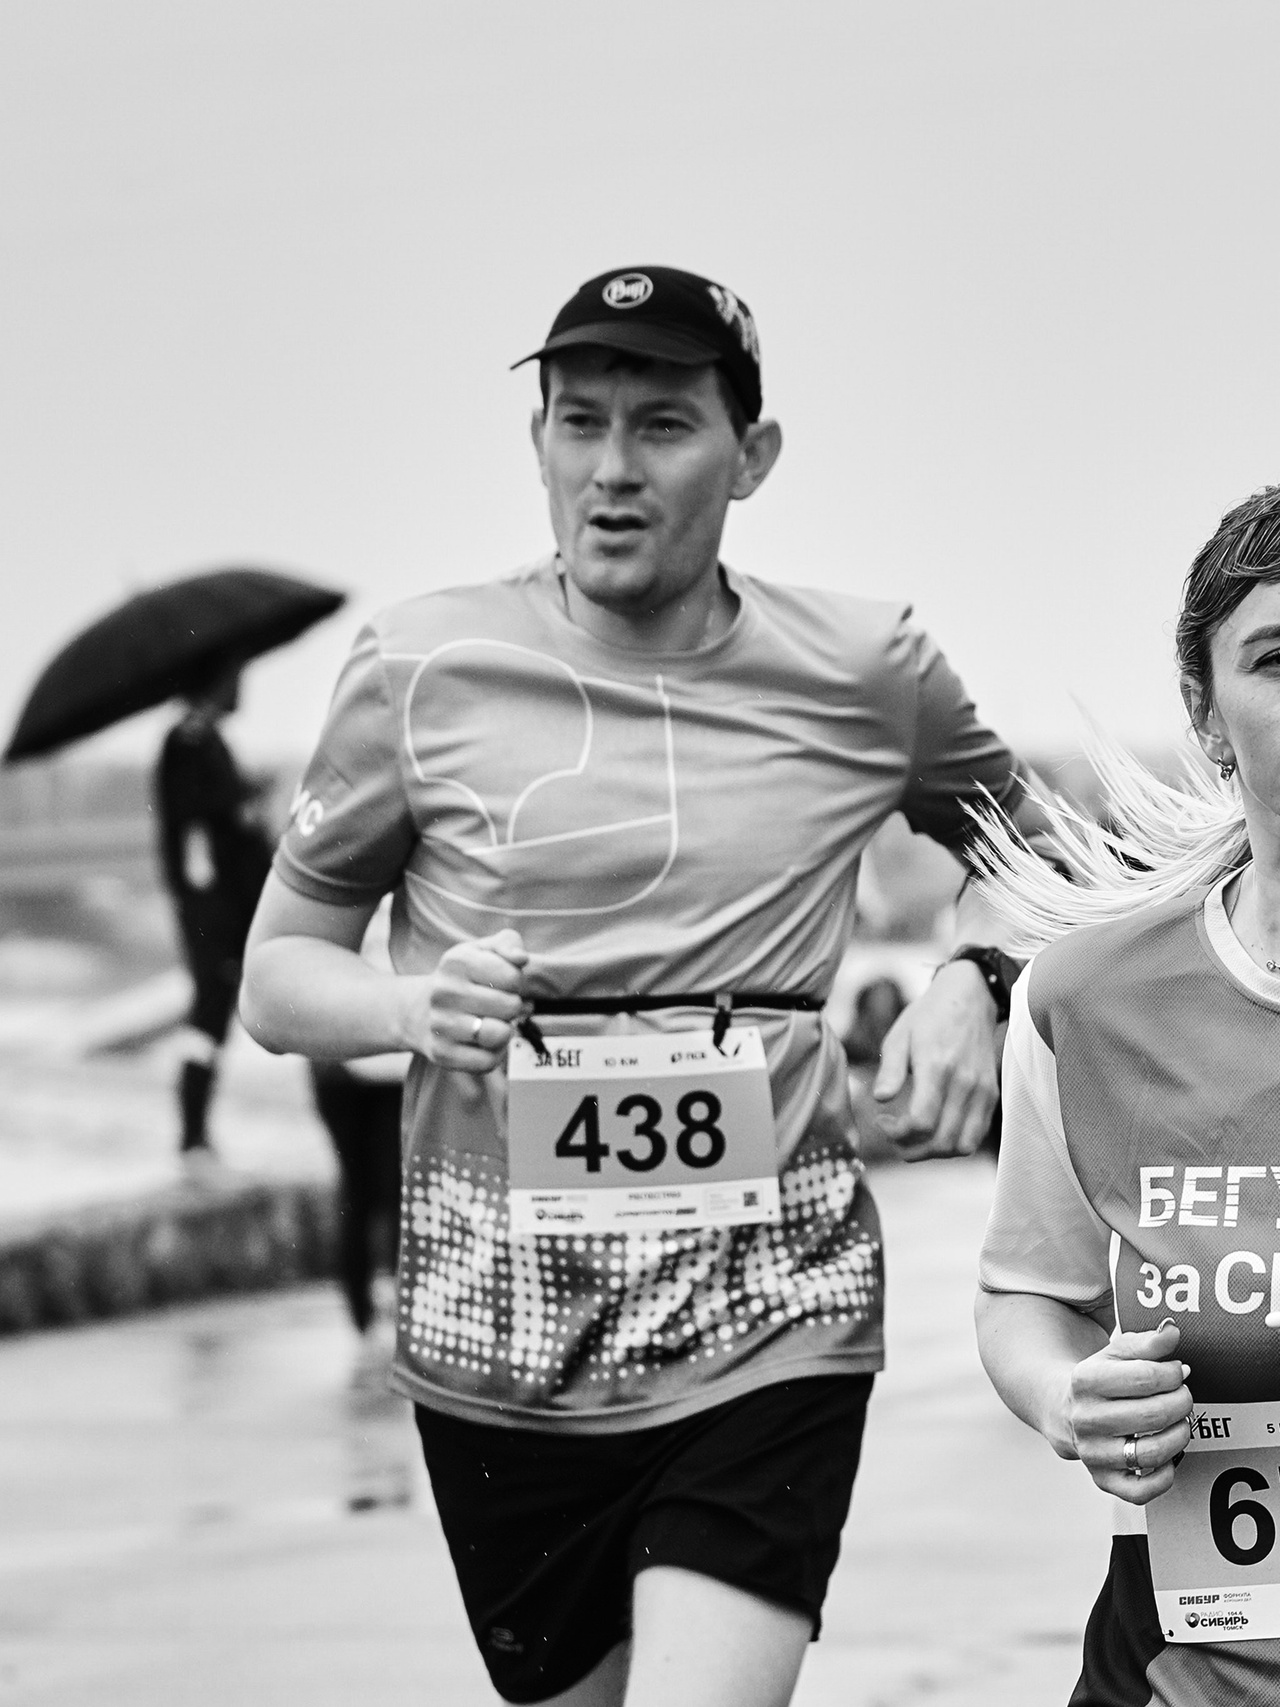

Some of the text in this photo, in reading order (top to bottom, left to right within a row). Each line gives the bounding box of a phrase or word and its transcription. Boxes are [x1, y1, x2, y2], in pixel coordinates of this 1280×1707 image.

[555, 1090, 726, 1173] 438
[1136, 1261, 1200, 1313] за
[1199, 1417, 1232, 1439] БЕГ
[1267, 1423, 1275, 1433] 5
[1179, 1594, 1220, 1605] СИБУР
[1200, 1610, 1224, 1618] РАДИО
[1200, 1615, 1249, 1627] СИБИРЬ
